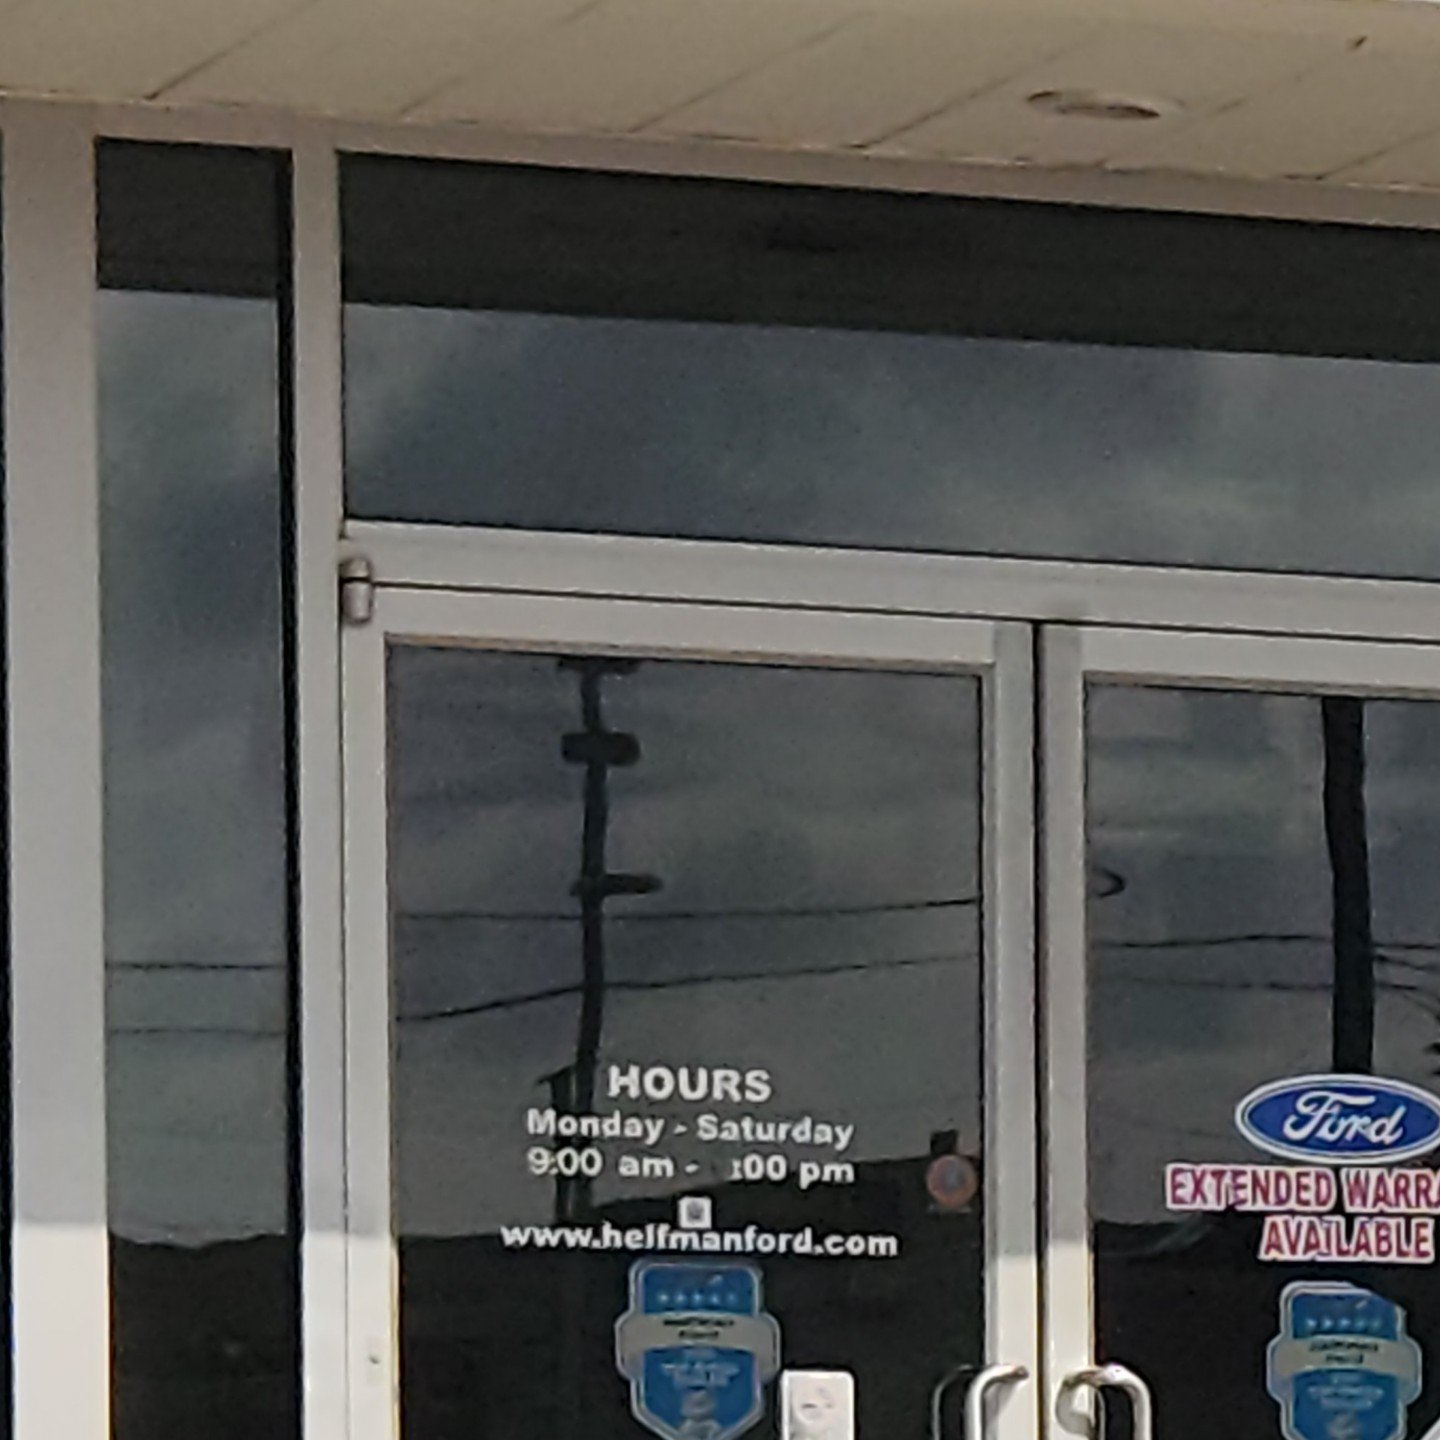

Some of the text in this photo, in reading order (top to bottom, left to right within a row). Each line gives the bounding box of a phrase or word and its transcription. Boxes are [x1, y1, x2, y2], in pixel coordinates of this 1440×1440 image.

[606, 1064, 773, 1103] HOURS
[526, 1107, 665, 1146] Monday
[697, 1113, 855, 1151] Saturday
[1282, 1089, 1406, 1146] Ford
[526, 1147, 604, 1177] 9:00
[618, 1156, 674, 1178] am
[799, 1161, 856, 1190] pm
[1169, 1168, 1334, 1207] EXTENDED
[500, 1222, 899, 1257] www.helfmanford.com
[1263, 1219, 1433, 1259] AVAILABLE
